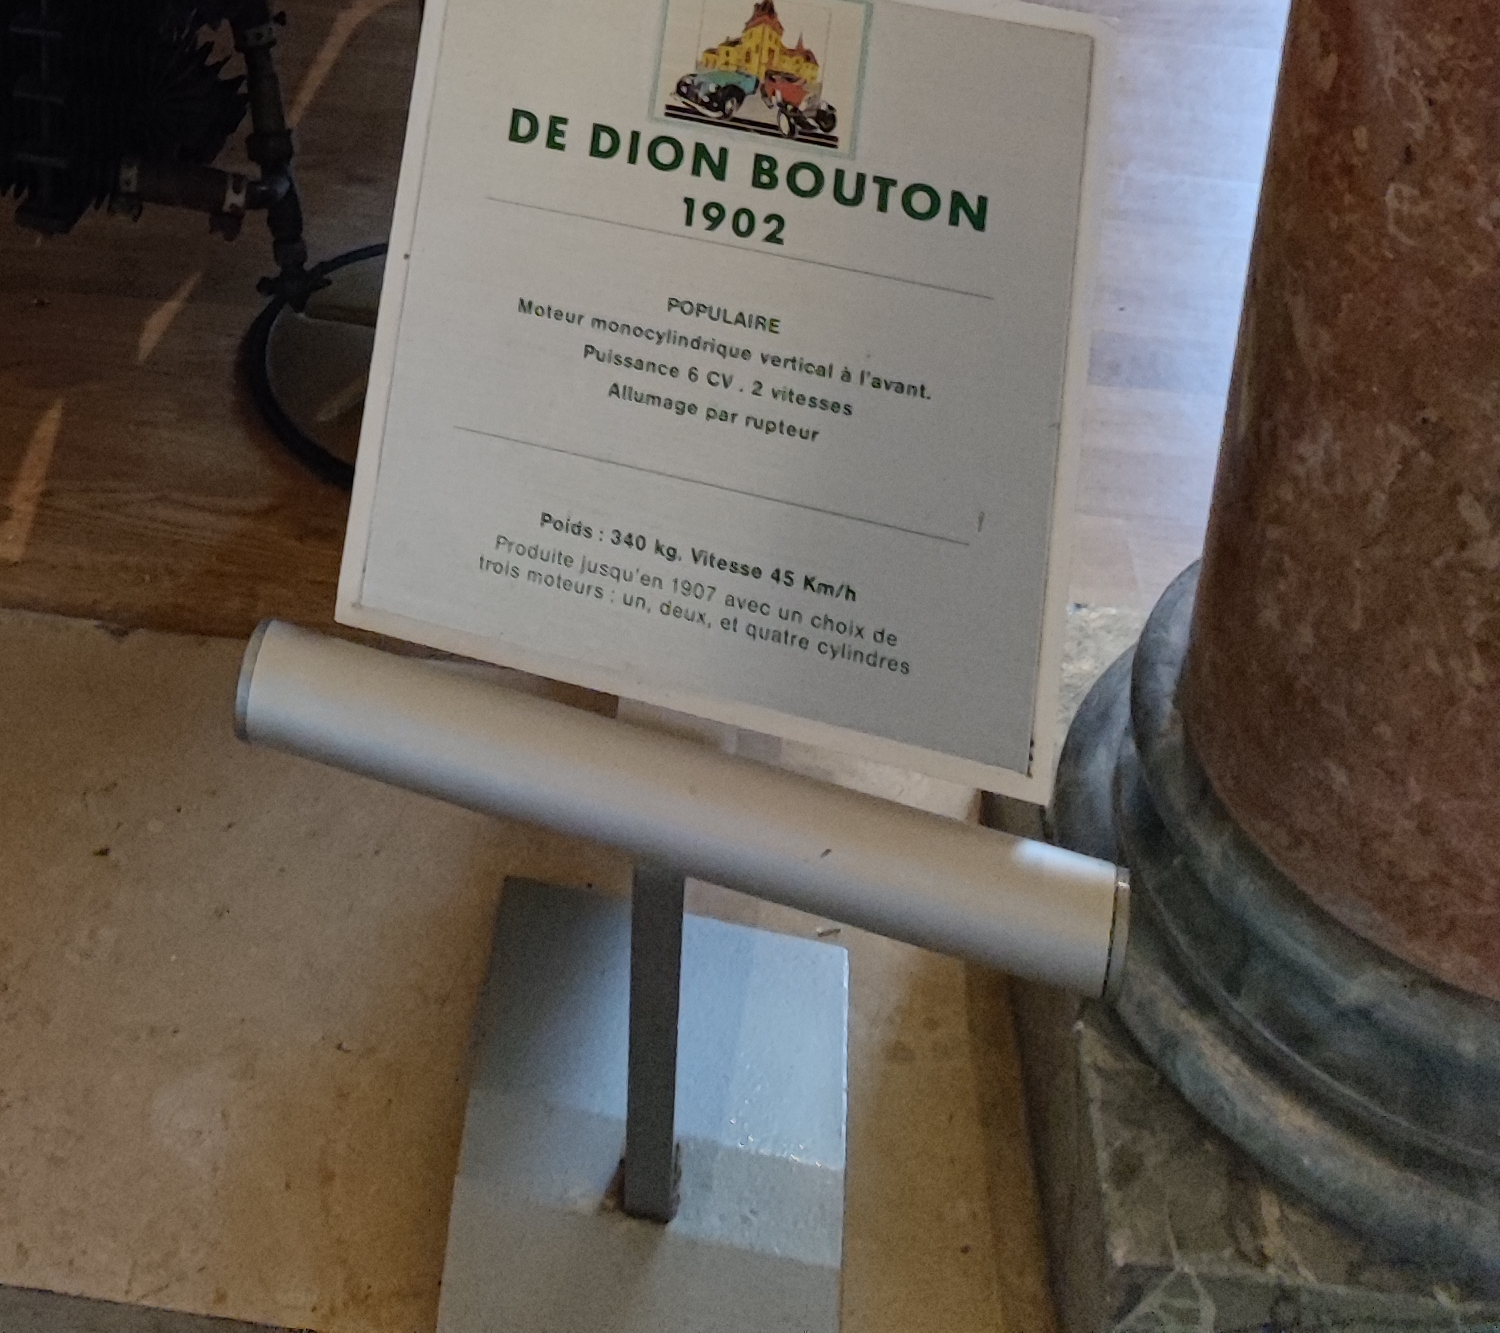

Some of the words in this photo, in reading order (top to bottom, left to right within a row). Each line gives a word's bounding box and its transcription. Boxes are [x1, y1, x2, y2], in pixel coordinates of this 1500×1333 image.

[508, 107, 569, 151] DE
[589, 122, 728, 182] DION
[751, 153, 988, 232] BOUTON
[683, 196, 785, 245] 1902
[518, 297, 585, 326] Moteur
[591, 316, 752, 361] monocylindrique
[760, 352, 834, 379] vertical
[840, 366, 852, 383] à
[860, 369, 931, 400] l'avant.
[667, 297, 781, 334] POPULAIRE
[583, 344, 679, 379] Puissance
[688, 366, 699, 382] 6
[706, 370, 734, 389] CV
[751, 380, 763, 397] 2
[771, 386, 853, 416] vitesses
[608, 382, 698, 416] Allumage
[705, 407, 739, 424] par
[745, 415, 820, 442] rupteur
[495, 534, 574, 568] Produite
[580, 555, 664, 590] jusqu'en
[673, 577, 717, 602] 1907
[724, 594, 771, 616] avec
[778, 607, 803, 624] un
[810, 614, 865, 640] choix
[873, 628, 898, 647] de
[540, 512, 593, 539] Poids
[611, 529, 647, 551] 340
[654, 539, 682, 562] kg.
[691, 547, 763, 579] Vitesse
[770, 567, 795, 587] 45
[803, 574, 857, 602] Km/h
[479, 556, 520, 579] trois
[527, 568, 604, 600] moteurs
[622, 592, 651, 614] un,
[659, 600, 711, 629] deux,
[720, 616, 738, 633] et
[746, 622, 809, 650] quatre
[817, 641, 910, 675] cylindres
